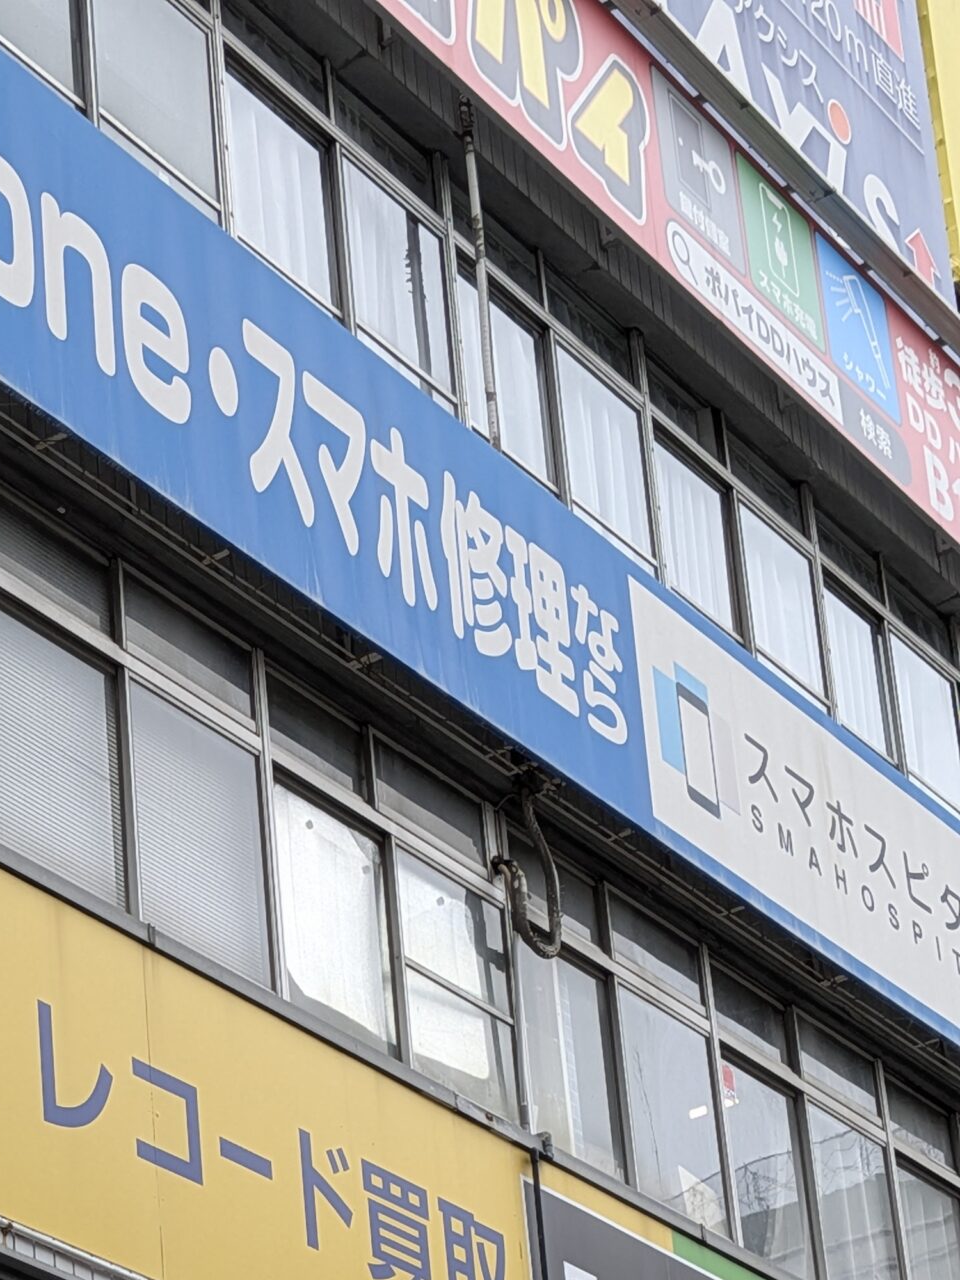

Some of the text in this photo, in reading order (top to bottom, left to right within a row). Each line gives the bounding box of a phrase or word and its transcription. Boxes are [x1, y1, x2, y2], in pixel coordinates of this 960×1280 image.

[704, 265, 836, 407] ポパイDDハウス
[842, 352, 887, 401] シャワー
[860, 408, 893, 459] 検索
